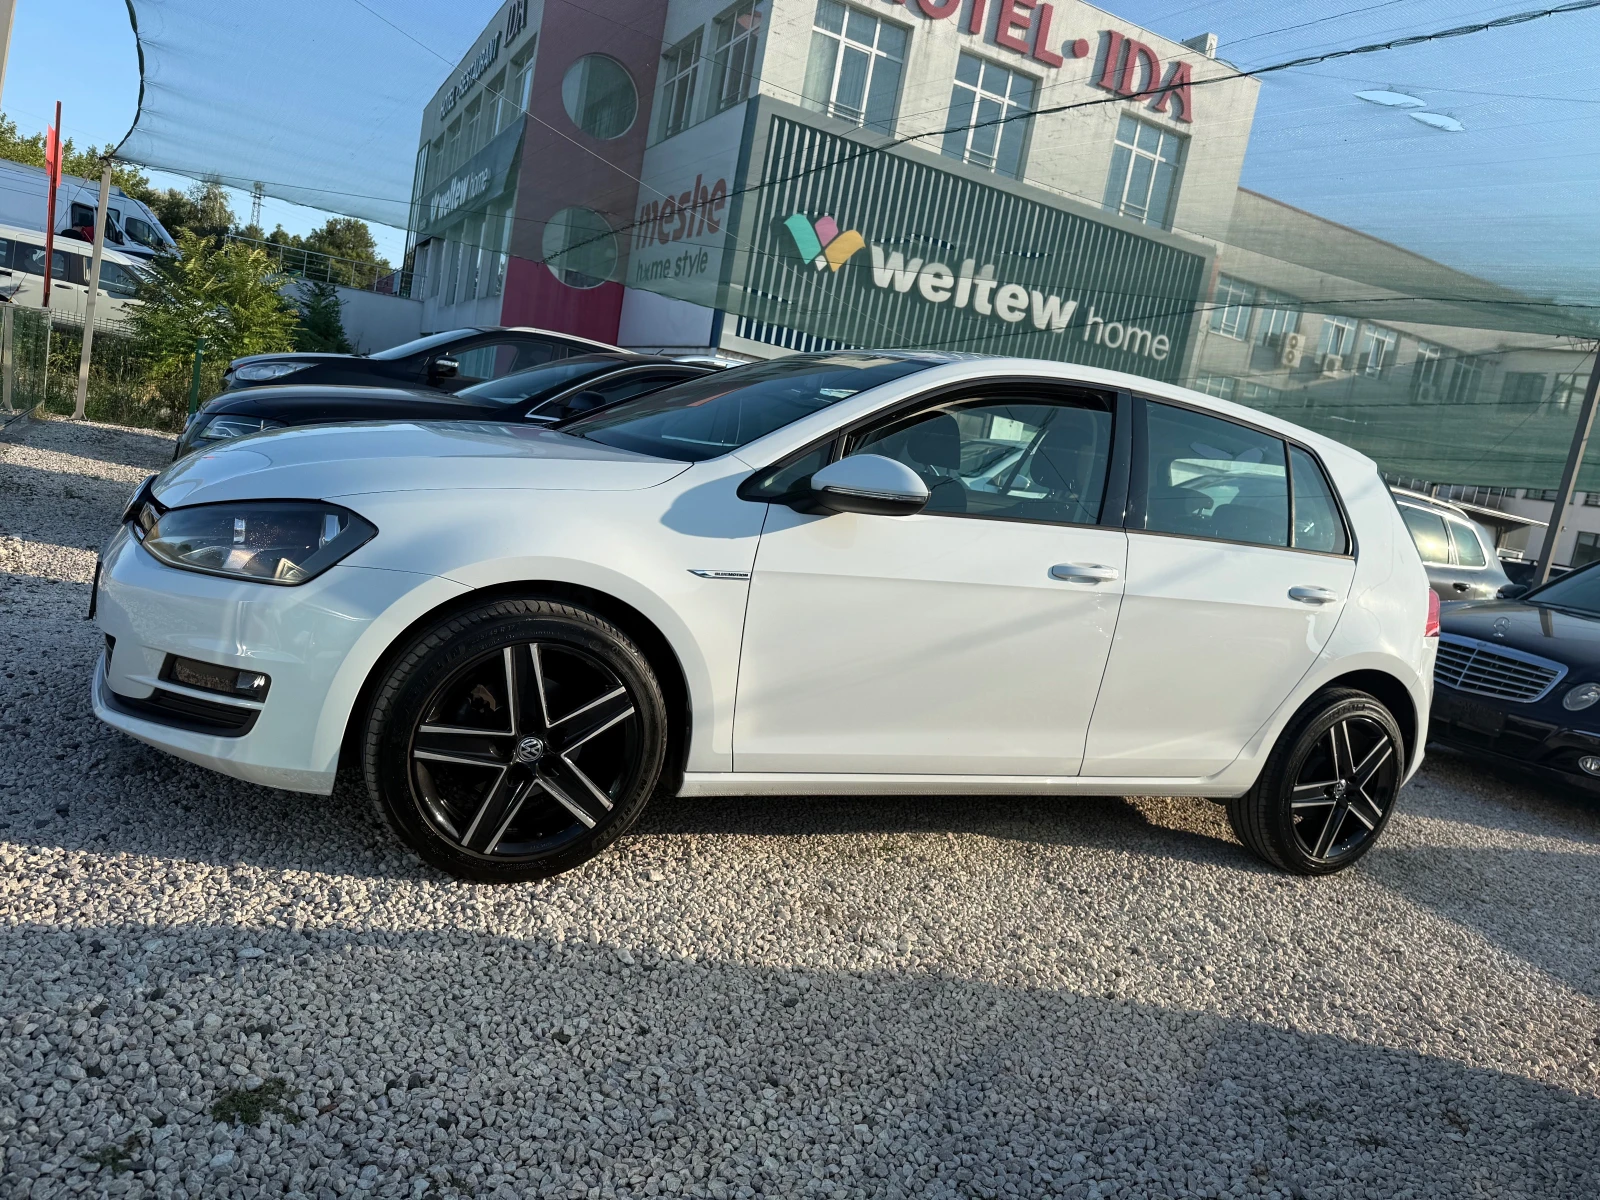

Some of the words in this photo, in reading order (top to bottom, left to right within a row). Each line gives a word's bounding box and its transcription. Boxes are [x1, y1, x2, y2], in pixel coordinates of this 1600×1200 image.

[1097, 29, 1193, 123] IDA
[437, 173, 470, 220] weltew
[467, 167, 489, 200] home
[635, 173, 727, 250] meshe
[674, 247, 708, 278] style
[870, 244, 1078, 334] weltew
[1083, 306, 1170, 360] home
